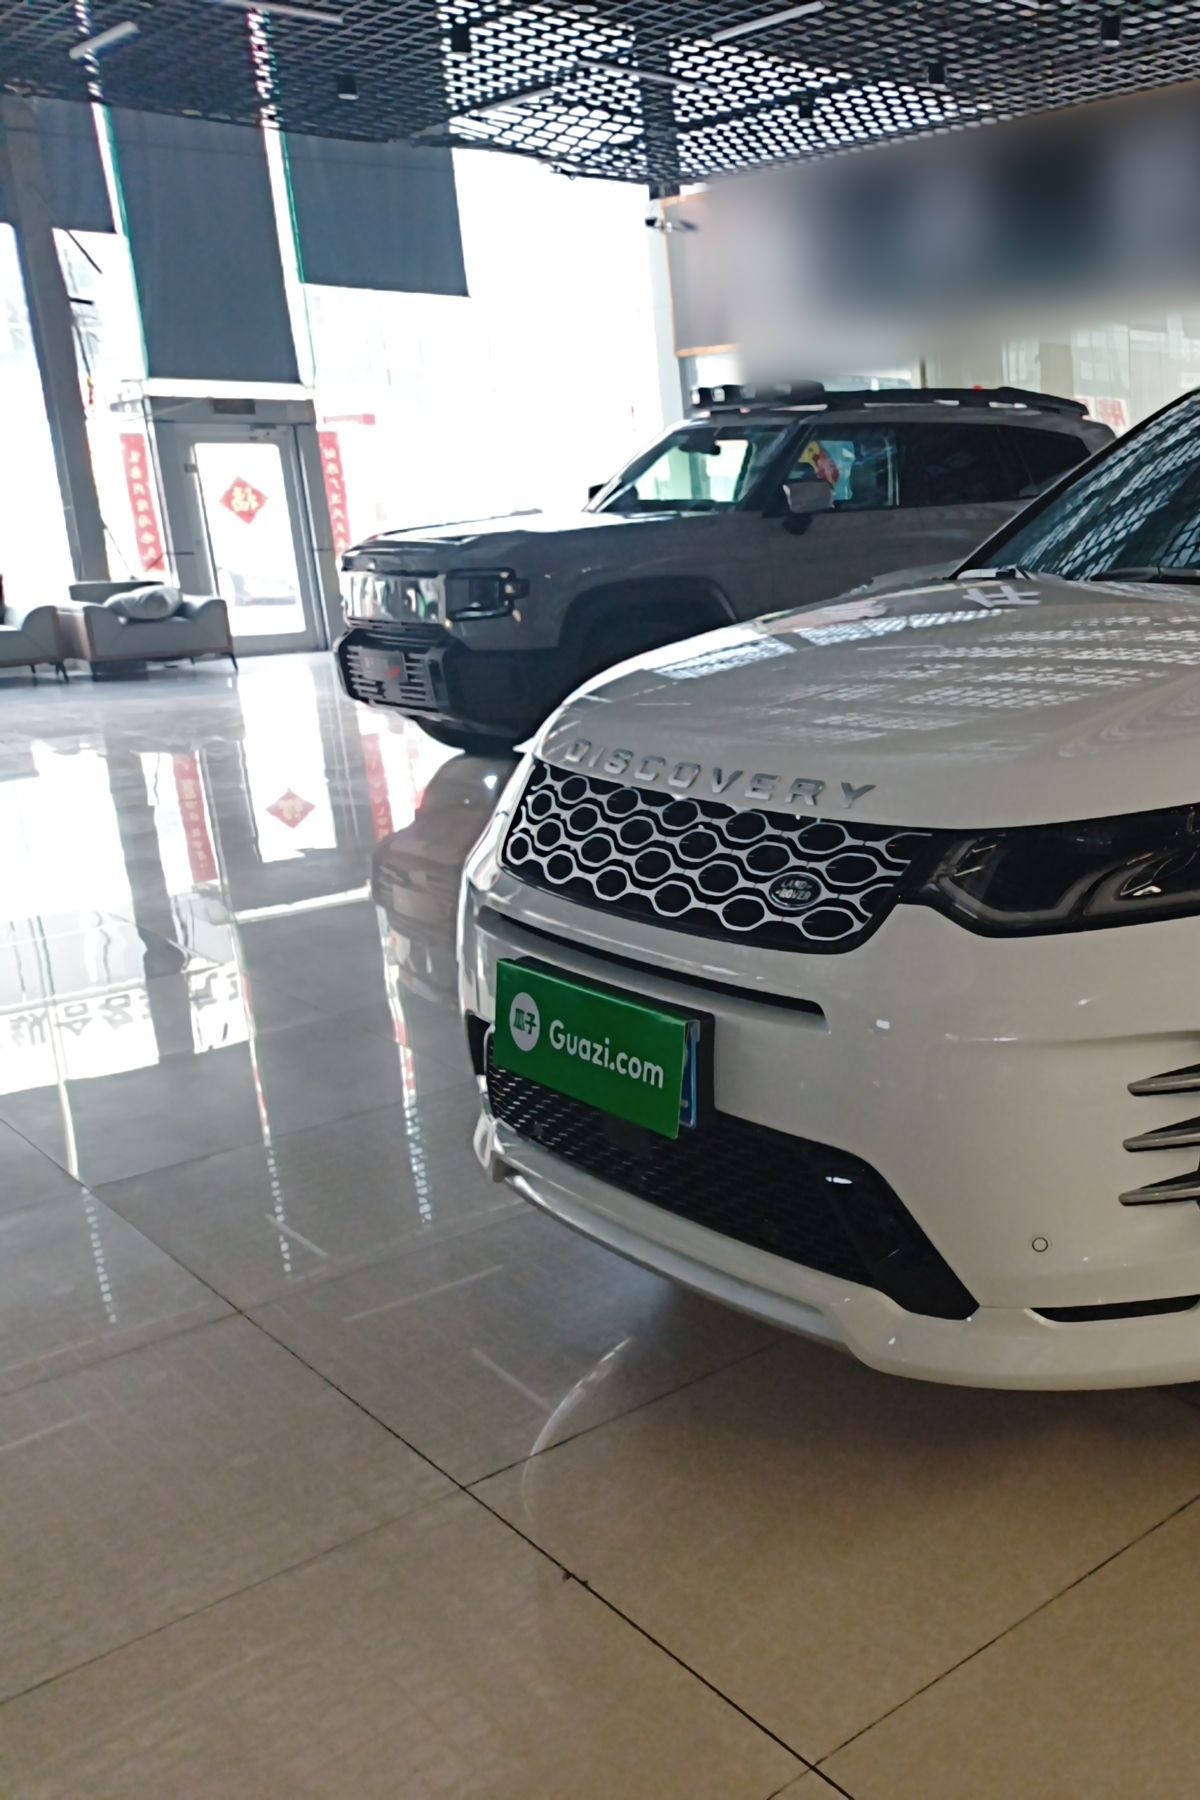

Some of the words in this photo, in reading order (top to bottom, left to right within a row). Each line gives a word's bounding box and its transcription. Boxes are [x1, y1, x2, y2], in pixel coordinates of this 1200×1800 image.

[565, 738, 877, 809] DISCOVERY
[513, 1008, 537, 1035] 瓜子
[549, 1019, 664, 1089] Guazi.com
